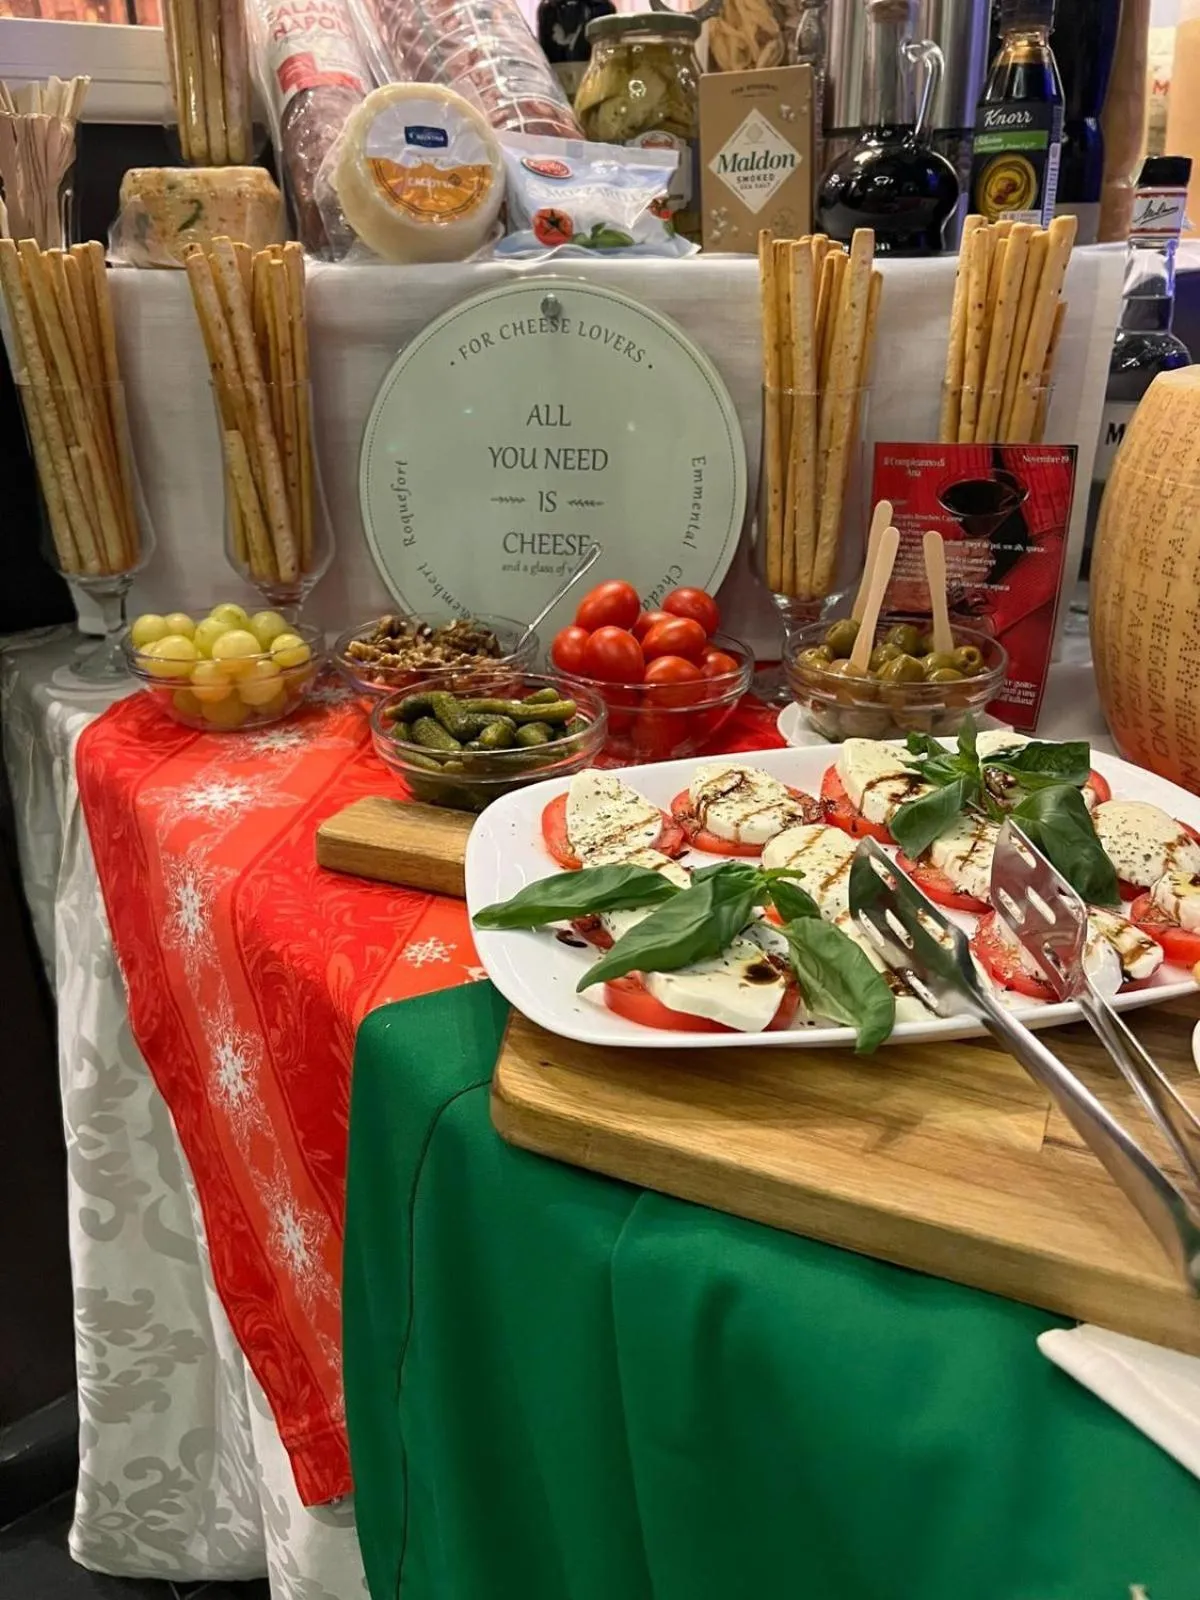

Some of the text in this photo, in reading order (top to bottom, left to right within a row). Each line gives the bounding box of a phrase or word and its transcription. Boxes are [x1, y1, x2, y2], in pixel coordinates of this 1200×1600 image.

[984, 107, 1033, 127] Knorr
[717, 150, 795, 174] Maldon
[736, 173, 775, 184] SMOKED
[459, 318, 646, 363] FOR CHEESE LOVERS
[526, 404, 572, 427] ALL
[488, 446, 608, 471] YOU NEED
[390, 460, 417, 547] Roquefort
[538, 490, 557, 513] IS
[682, 455, 706, 549] Emmental
[502, 532, 591, 556] CHEESE
[502, 560, 520, 572] and
[523, 564, 529, 572] a
[530, 560, 554, 577] glass
[556, 560, 567, 577] of
